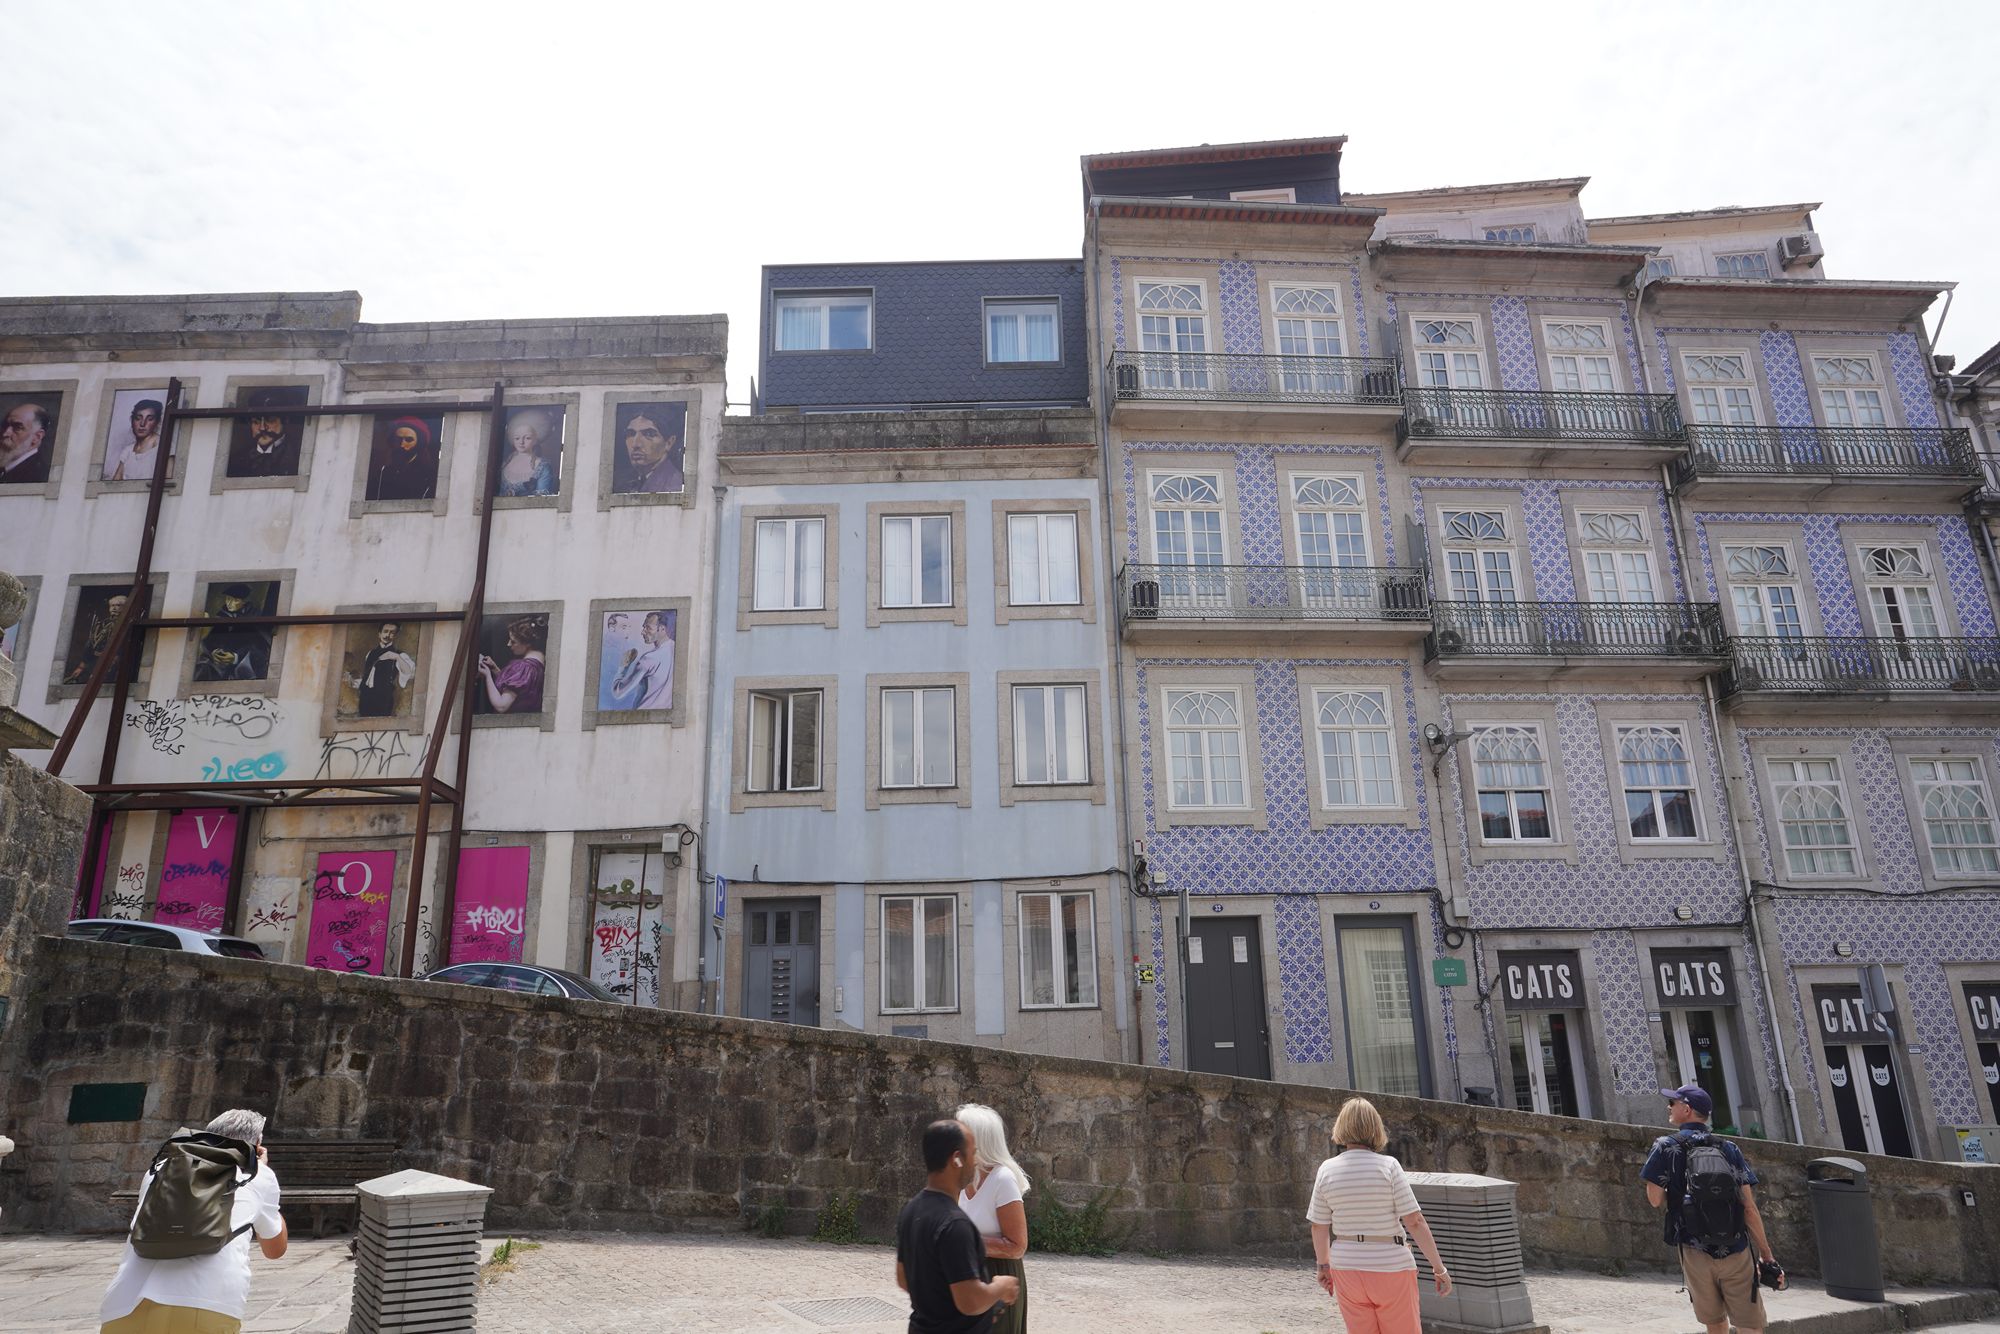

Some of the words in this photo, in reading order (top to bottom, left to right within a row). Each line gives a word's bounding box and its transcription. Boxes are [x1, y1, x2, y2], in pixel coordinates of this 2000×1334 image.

[194, 815, 224, 849] V
[337, 861, 372, 896] O
[717, 879, 724, 913] P
[1507, 964, 1574, 1000] CATS
[1659, 961, 1725, 997] CATS
[1697, 1037, 1710, 1045] CATS
[1832, 1073, 1845, 1081] CATS
[1874, 1072, 1888, 1080] CATS
